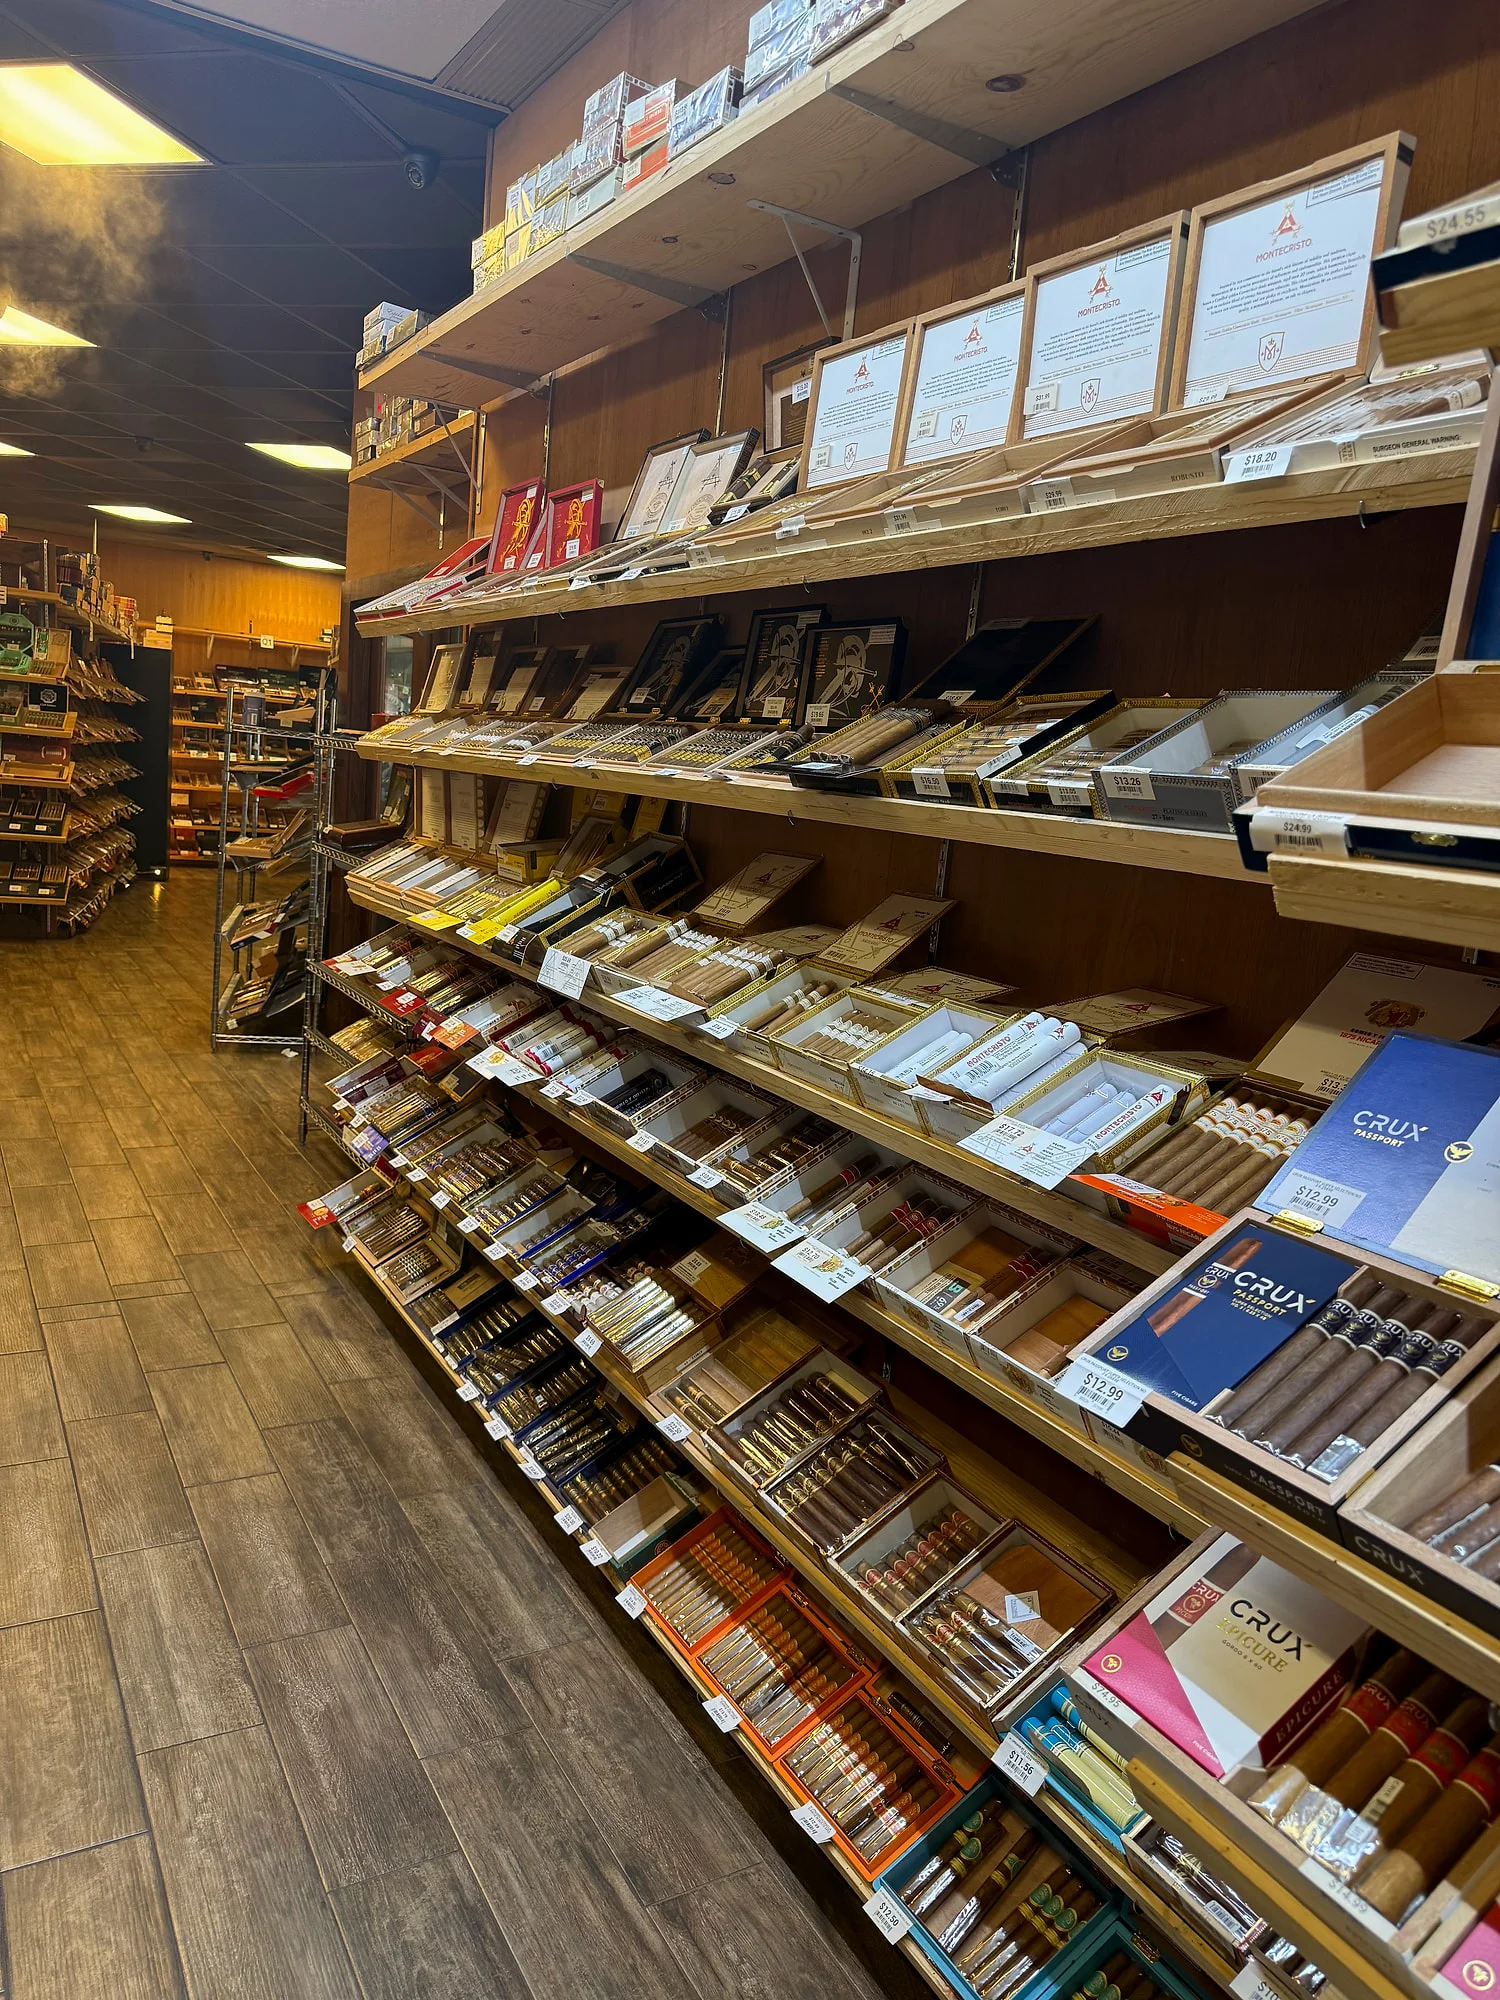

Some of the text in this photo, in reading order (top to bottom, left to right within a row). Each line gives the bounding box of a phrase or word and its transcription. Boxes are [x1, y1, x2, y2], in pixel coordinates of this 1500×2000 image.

[1427, 205, 1485, 239] $24.55
[1255, 238, 1312, 263] MONTECRISTO
[1077, 298, 1120, 318] MONTECRISTO
[953, 346, 988, 362] MONTECRISTO
[1244, 451, 1277, 466] $18.20
[1372, 443, 1401, 453] SURGEON
[1401, 439, 1430, 449] GENERAL
[1171, 471, 1204, 482] ROBUSTO
[1113, 776, 1141, 787] $13.26
[1283, 822, 1312, 834] $24.99
[966, 1034, 1011, 1068] MONTECRISTO
[1094, 1101, 1142, 1140] MONTECRISTO
[1353, 1110, 1429, 1142] CRUX
[1353, 1128, 1405, 1148] PASSPORT
[1296, 1184, 1339, 1207] $12.99
[1205, 1266, 1230, 1280] CRUX
[1233, 1288, 1287, 1316] PASSPORT
[1234, 1271, 1316, 1314] CRUX
[1083, 1371, 1124, 1401] $12.99
[1249, 1469, 1323, 1517] PASSPORT
[1355, 1535, 1425, 1586] CRUX
[1230, 1599, 1312, 1661] CRUX
[1216, 1617, 1288, 1673] EPICURE
[1092, 1682, 1121, 1707] $74.95
[1276, 1669, 1343, 1745] EPICURE
[1361, 1683, 1390, 1711] CRUX
[1009, 1749, 1033, 1775] $11.56
[1328, 1878, 1368, 1912] $14.99
[878, 1901, 900, 1927] $12.50
